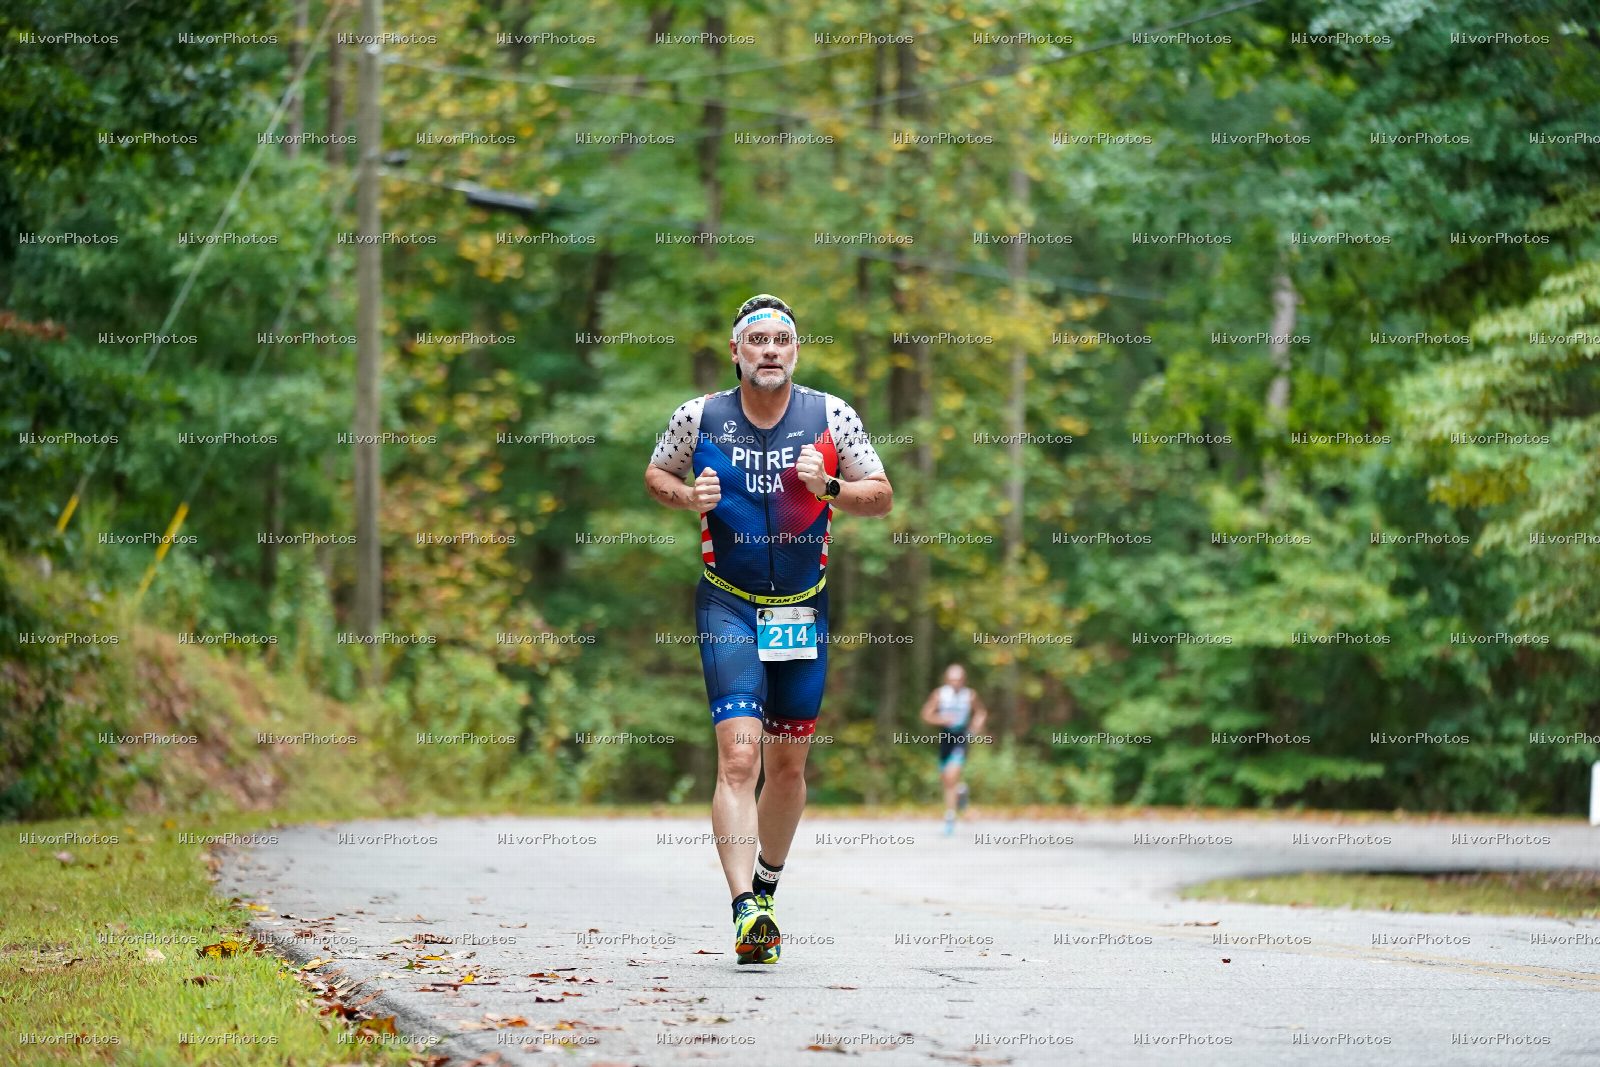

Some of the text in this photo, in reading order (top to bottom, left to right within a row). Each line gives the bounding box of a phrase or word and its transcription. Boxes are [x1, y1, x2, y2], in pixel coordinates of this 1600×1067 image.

[732, 446, 795, 470] PITRE
[745, 473, 785, 493] USA
[769, 626, 808, 647] 214
